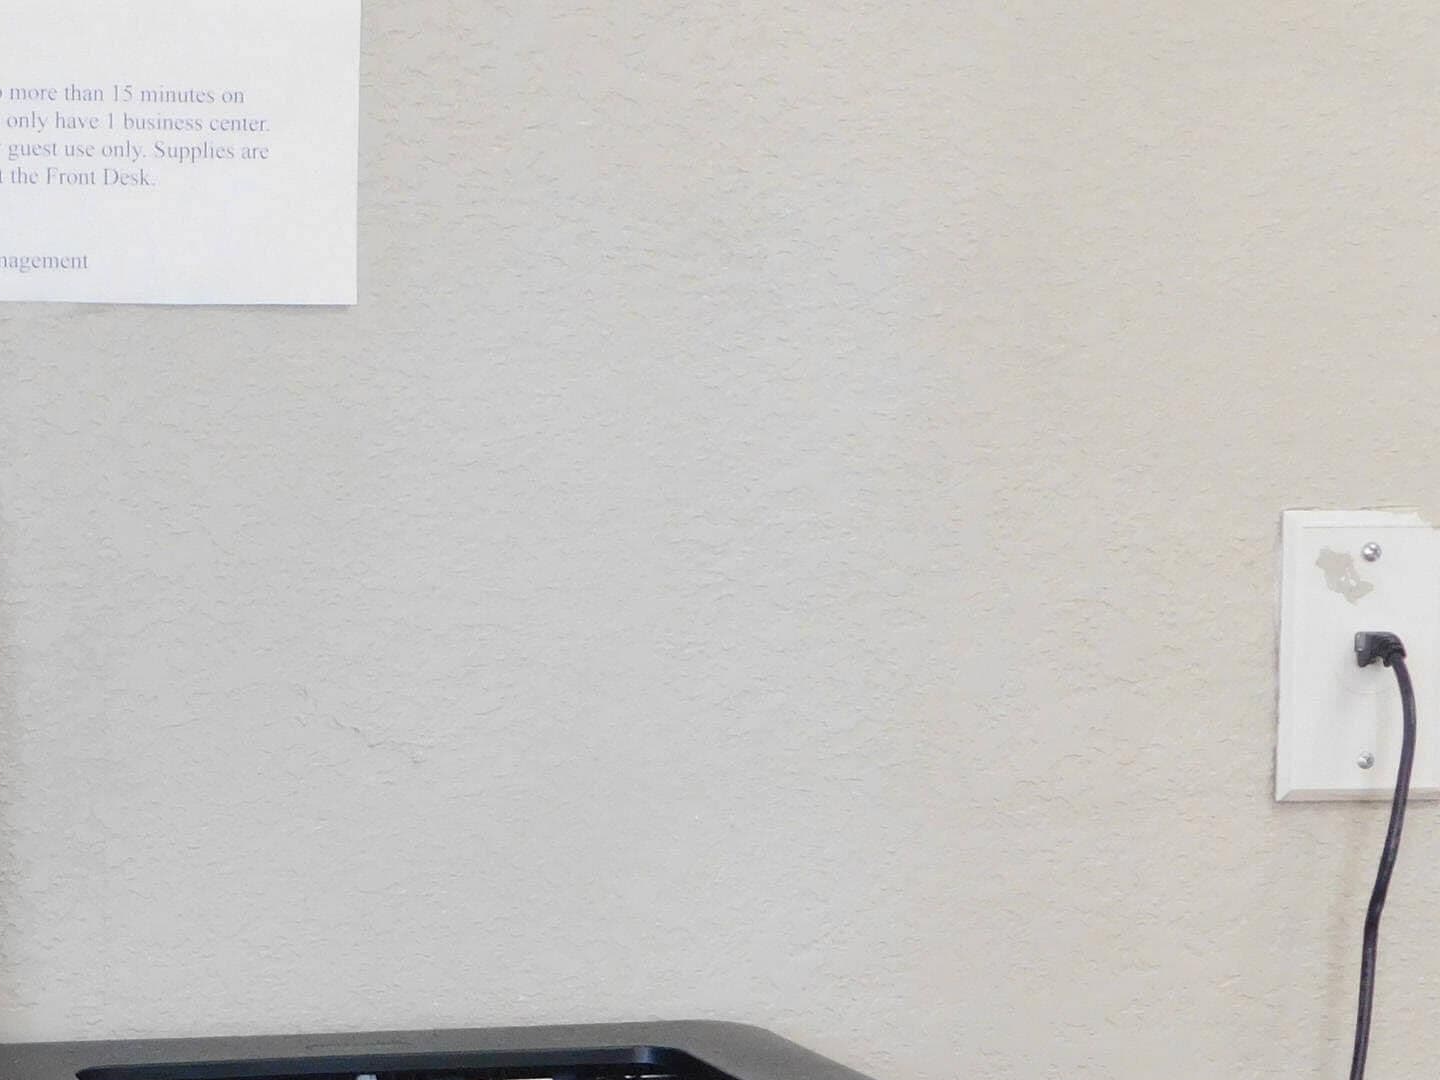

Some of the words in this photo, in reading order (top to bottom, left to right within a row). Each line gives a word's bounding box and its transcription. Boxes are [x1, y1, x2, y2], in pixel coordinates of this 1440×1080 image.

[9, 87, 58, 102] more
[63, 83, 104, 102] than
[113, 84, 133, 103] 15
[140, 84, 216, 104] minutes
[221, 90, 245, 104] on
[5, 110, 48, 134] only
[55, 110, 100, 130] have
[108, 112, 114, 130] 1
[123, 111, 203, 132] business
[208, 117, 270, 133] center.
[7, 142, 58, 162] guest
[64, 144, 96, 158] use
[100, 139, 147, 164] only.
[153, 140, 235, 165] Supplies
[240, 146, 270, 160] are
[10, 166, 39, 185] the
[46, 166, 96, 186] Front
[103, 167, 156, 187] Desk.
